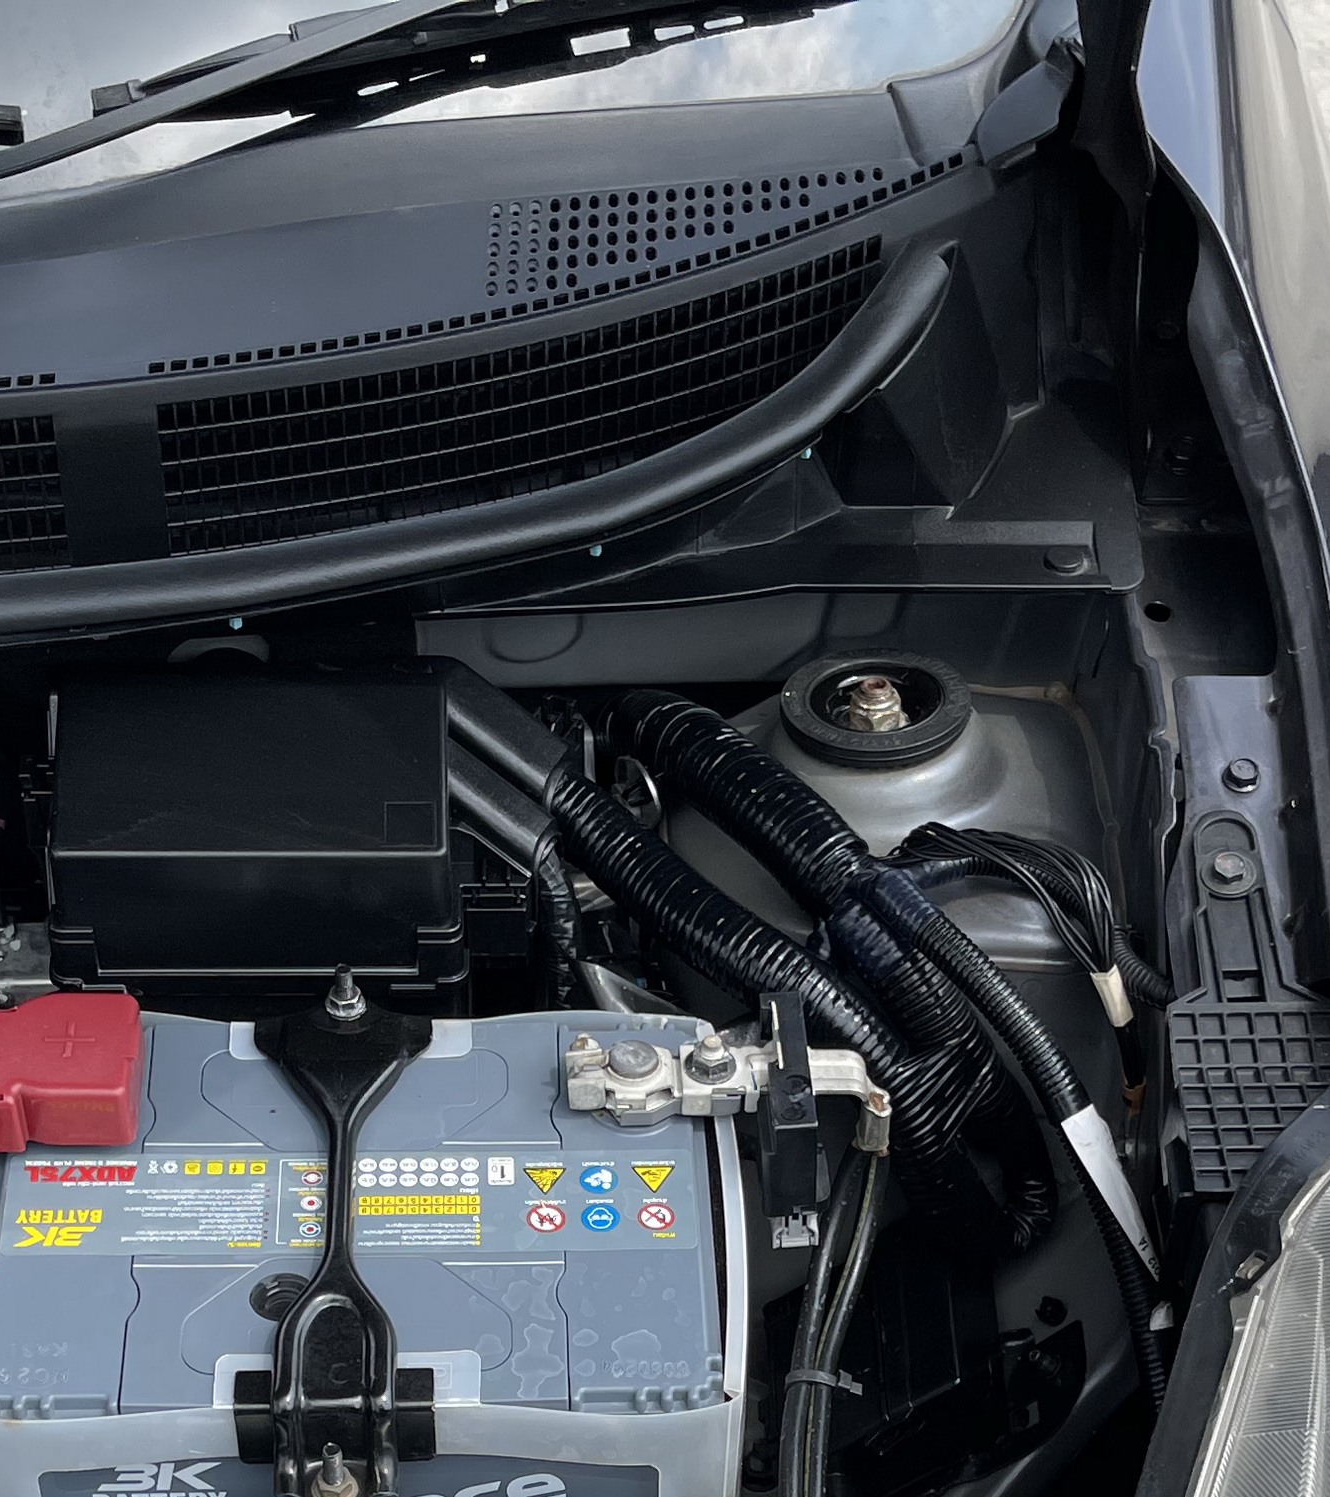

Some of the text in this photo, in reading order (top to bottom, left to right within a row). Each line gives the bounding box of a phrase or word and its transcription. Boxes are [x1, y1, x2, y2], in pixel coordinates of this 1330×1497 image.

[24, 1166, 138, 1183] ADX75L
[15, 1208, 103, 1224] BATTERY
[13, 1225, 97, 1248] 3K
[96, 1461, 225, 1491] 3K
